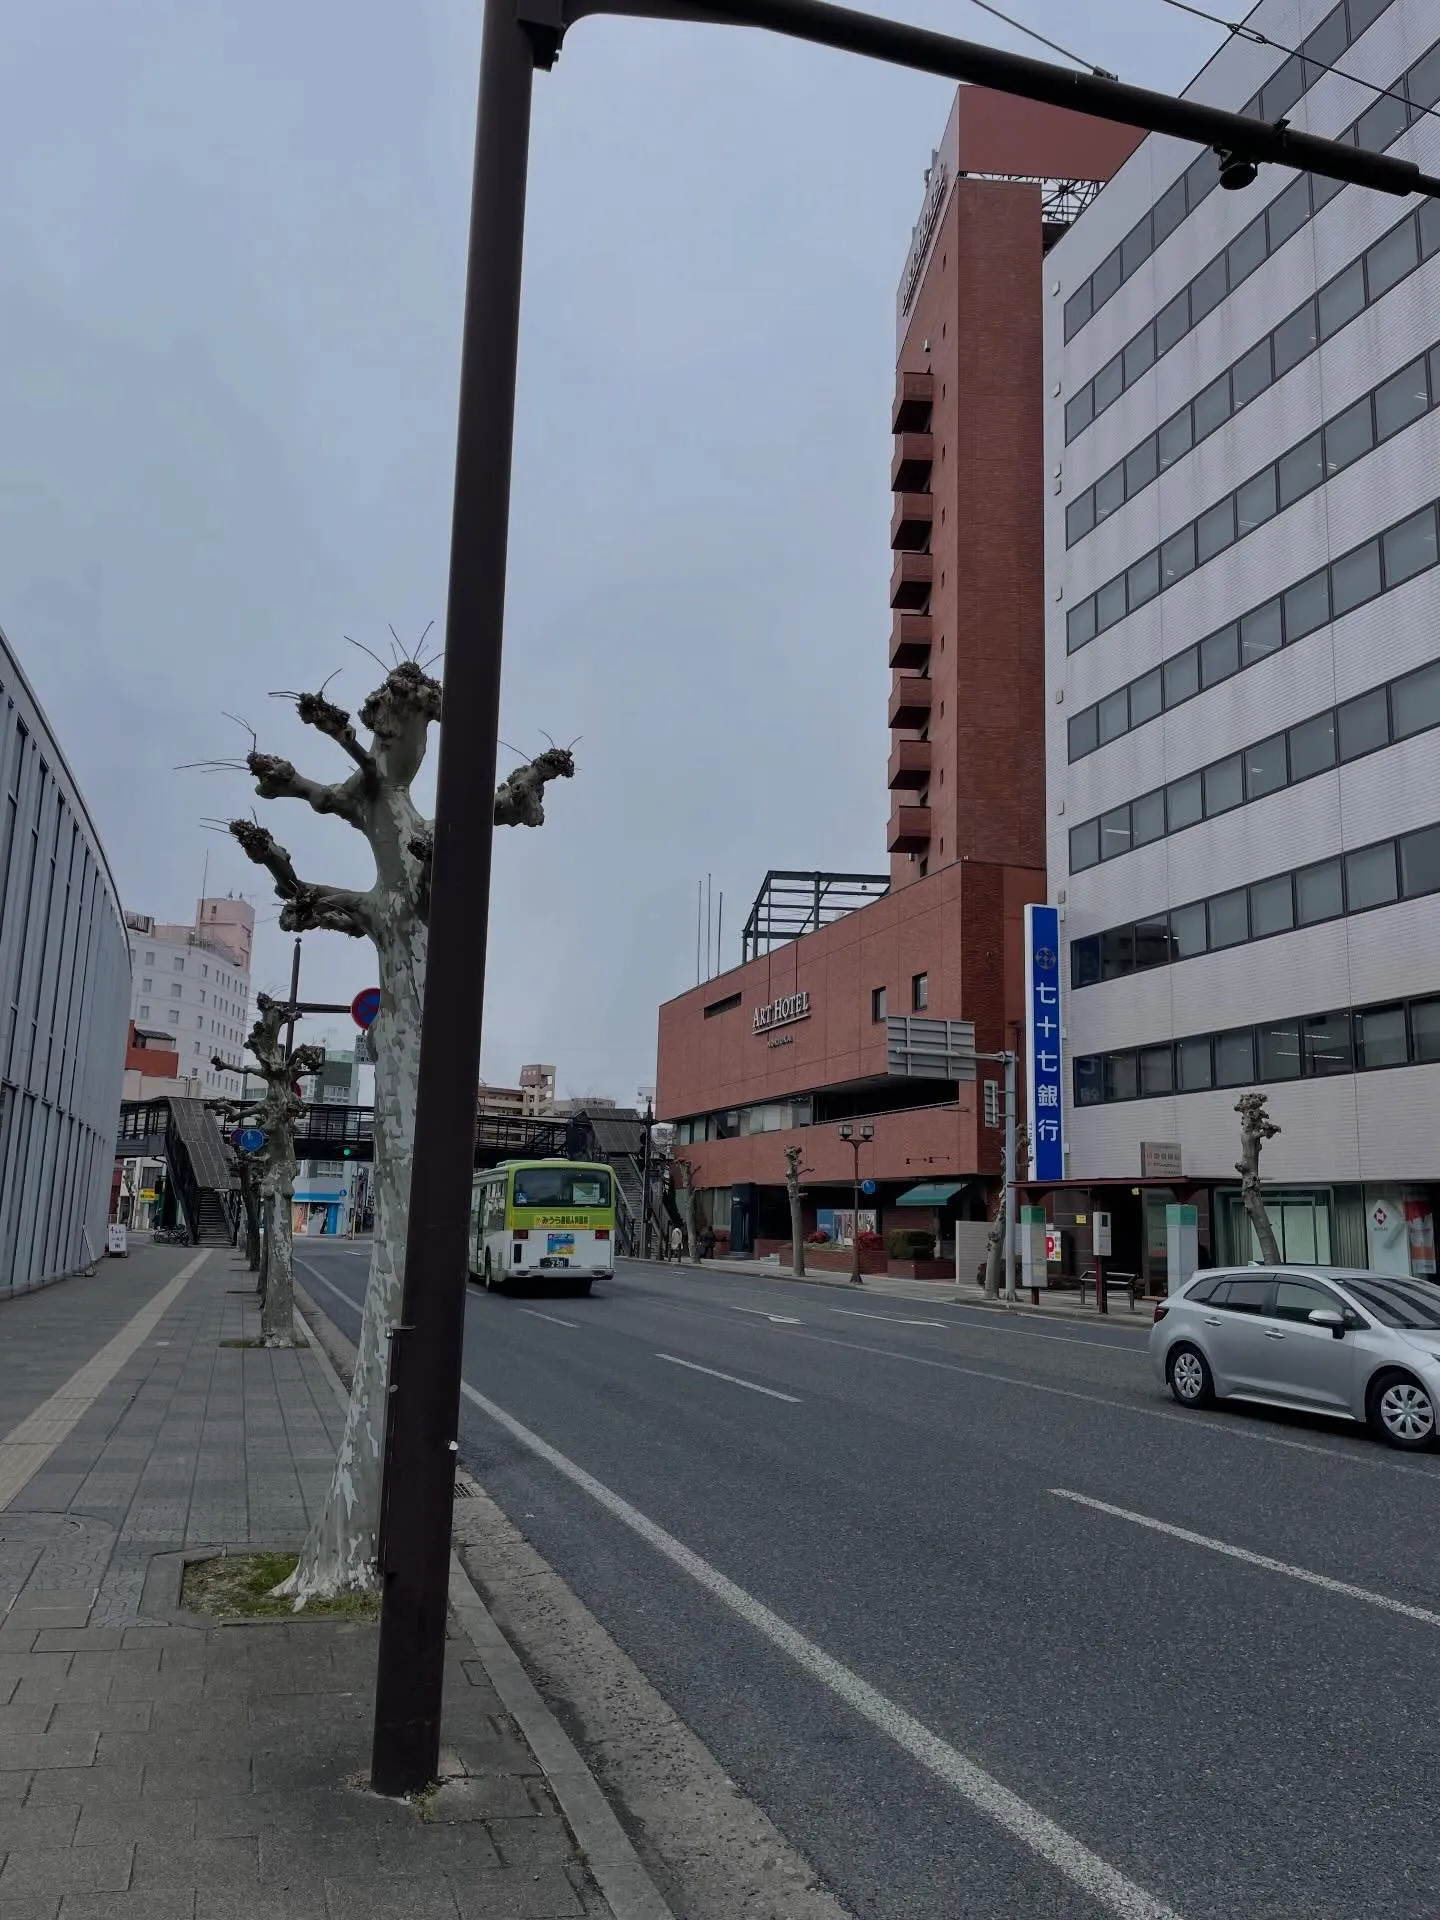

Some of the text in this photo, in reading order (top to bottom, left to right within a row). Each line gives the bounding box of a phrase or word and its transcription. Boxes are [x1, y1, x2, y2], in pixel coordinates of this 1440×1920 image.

[752, 992, 809, 1028] ART HOTEL
[1036, 982, 1059, 1142] 七十七銀行
